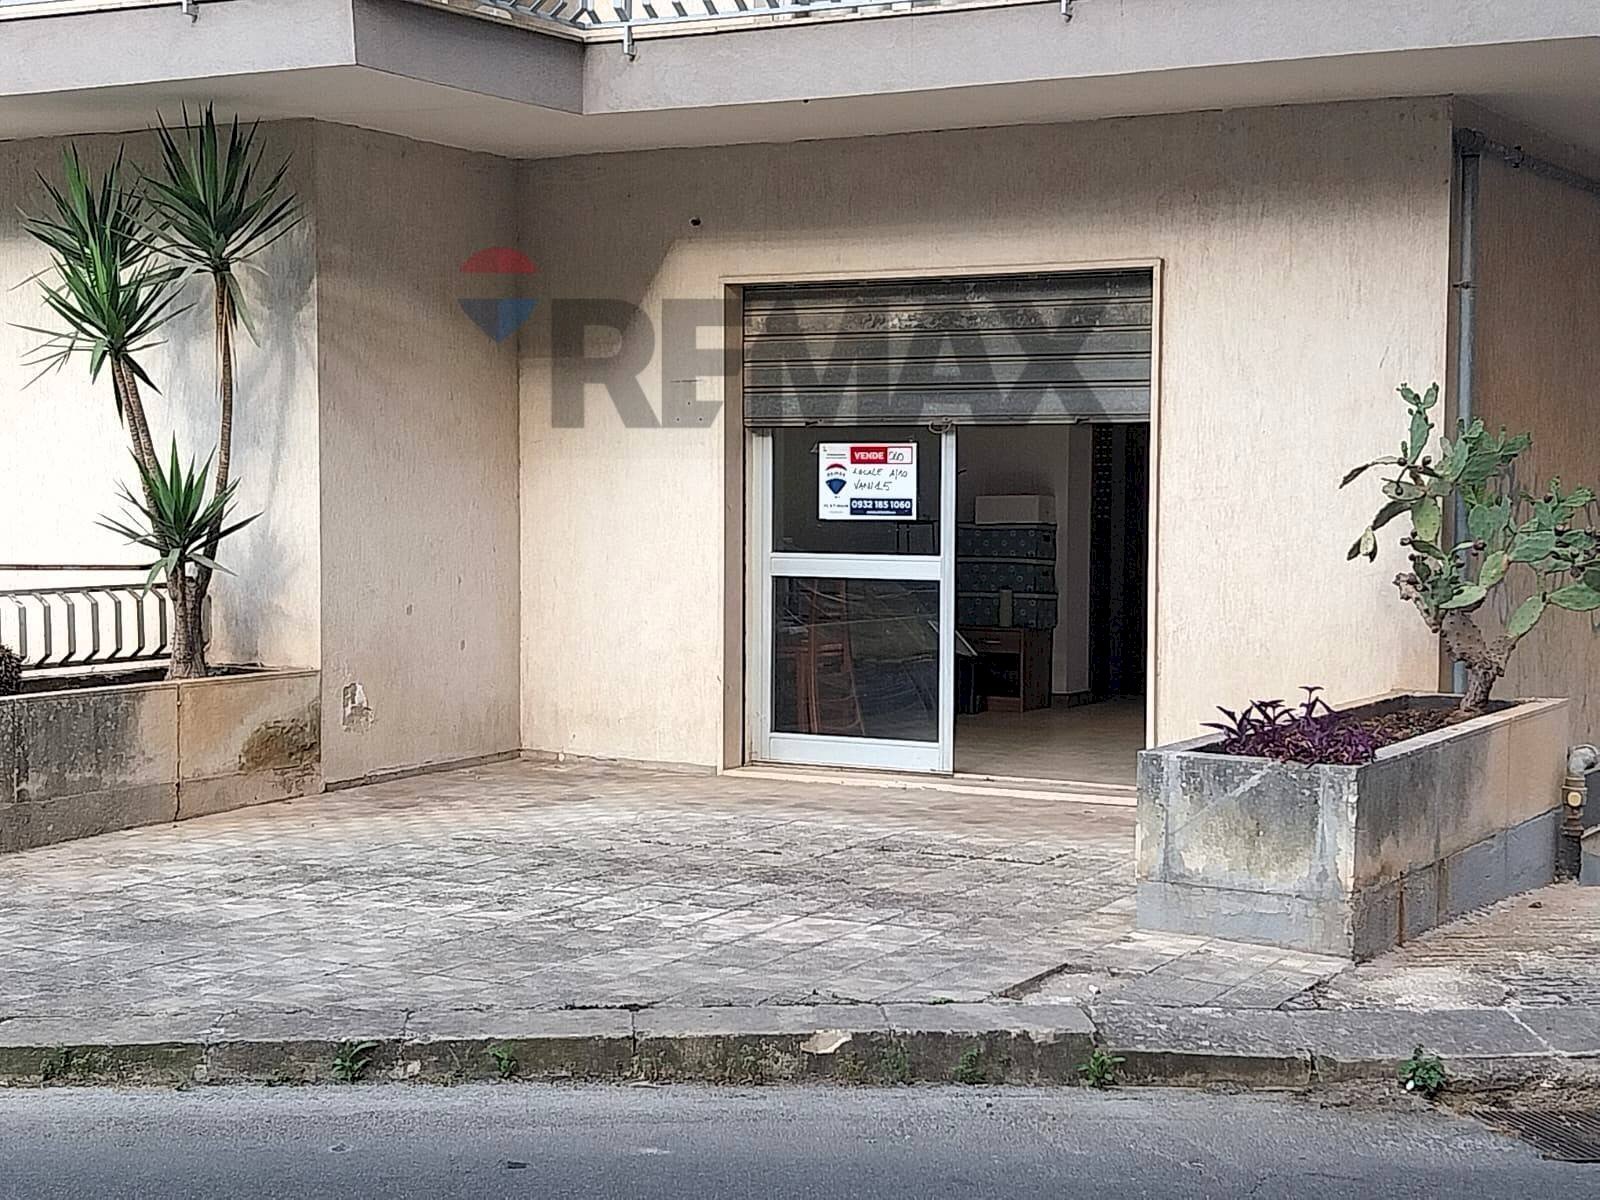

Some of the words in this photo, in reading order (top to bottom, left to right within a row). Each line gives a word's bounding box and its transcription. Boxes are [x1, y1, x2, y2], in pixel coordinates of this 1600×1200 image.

[854, 451, 885, 460] VENDE
[851, 499, 873, 509] 0932
[874, 500, 889, 509] 185
[890, 500, 911, 509] 1060
